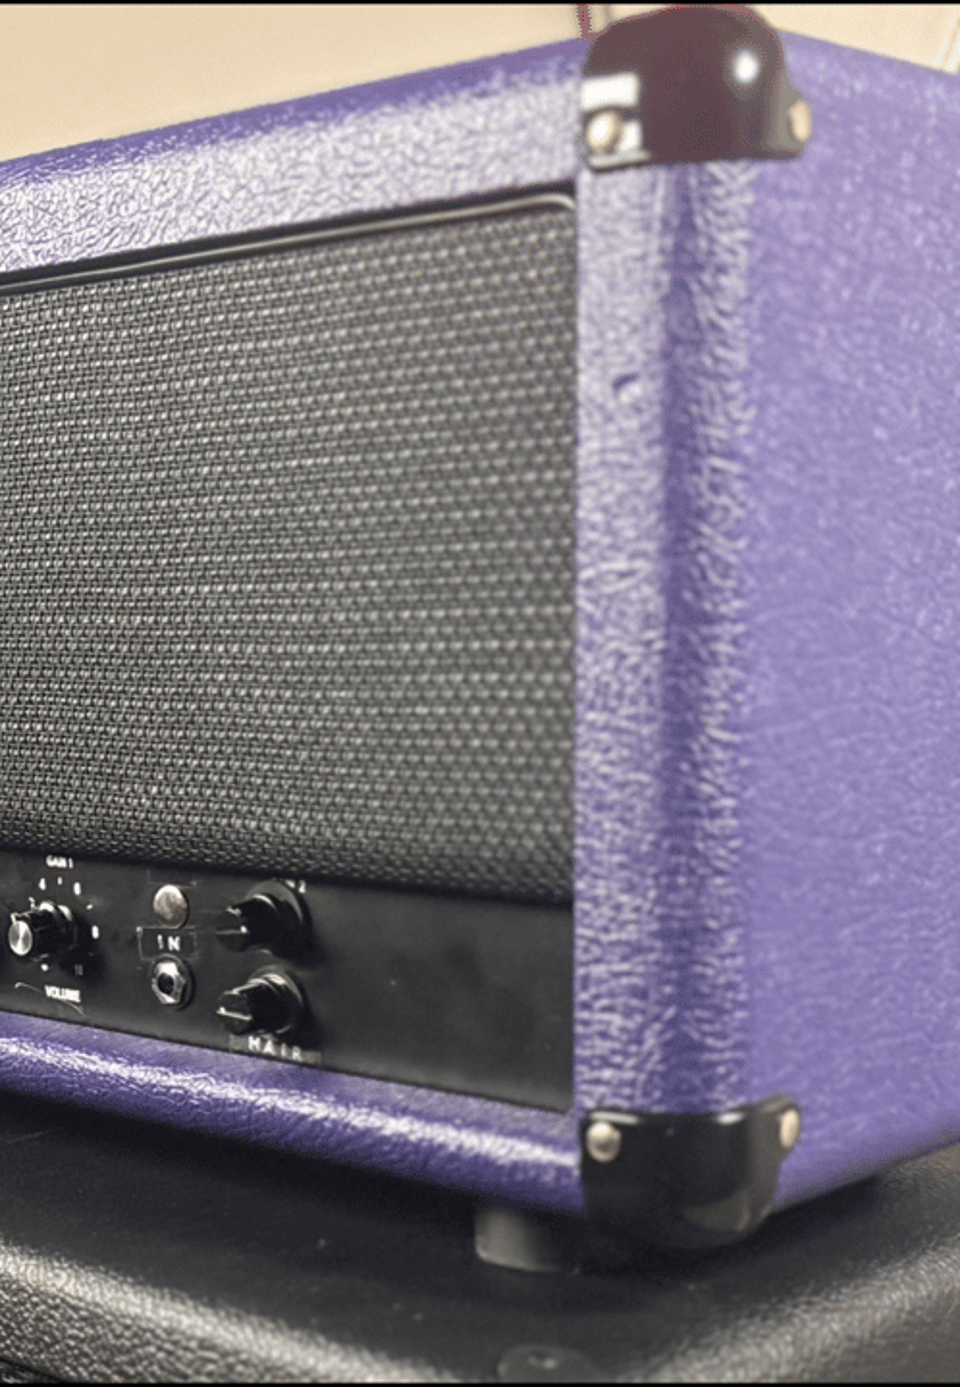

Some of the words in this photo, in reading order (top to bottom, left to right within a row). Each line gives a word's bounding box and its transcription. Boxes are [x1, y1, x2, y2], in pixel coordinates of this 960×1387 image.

[157, 934, 181, 951] IN
[44, 985, 82, 1003] VOLUME
[248, 1035, 302, 1062] HAIR
